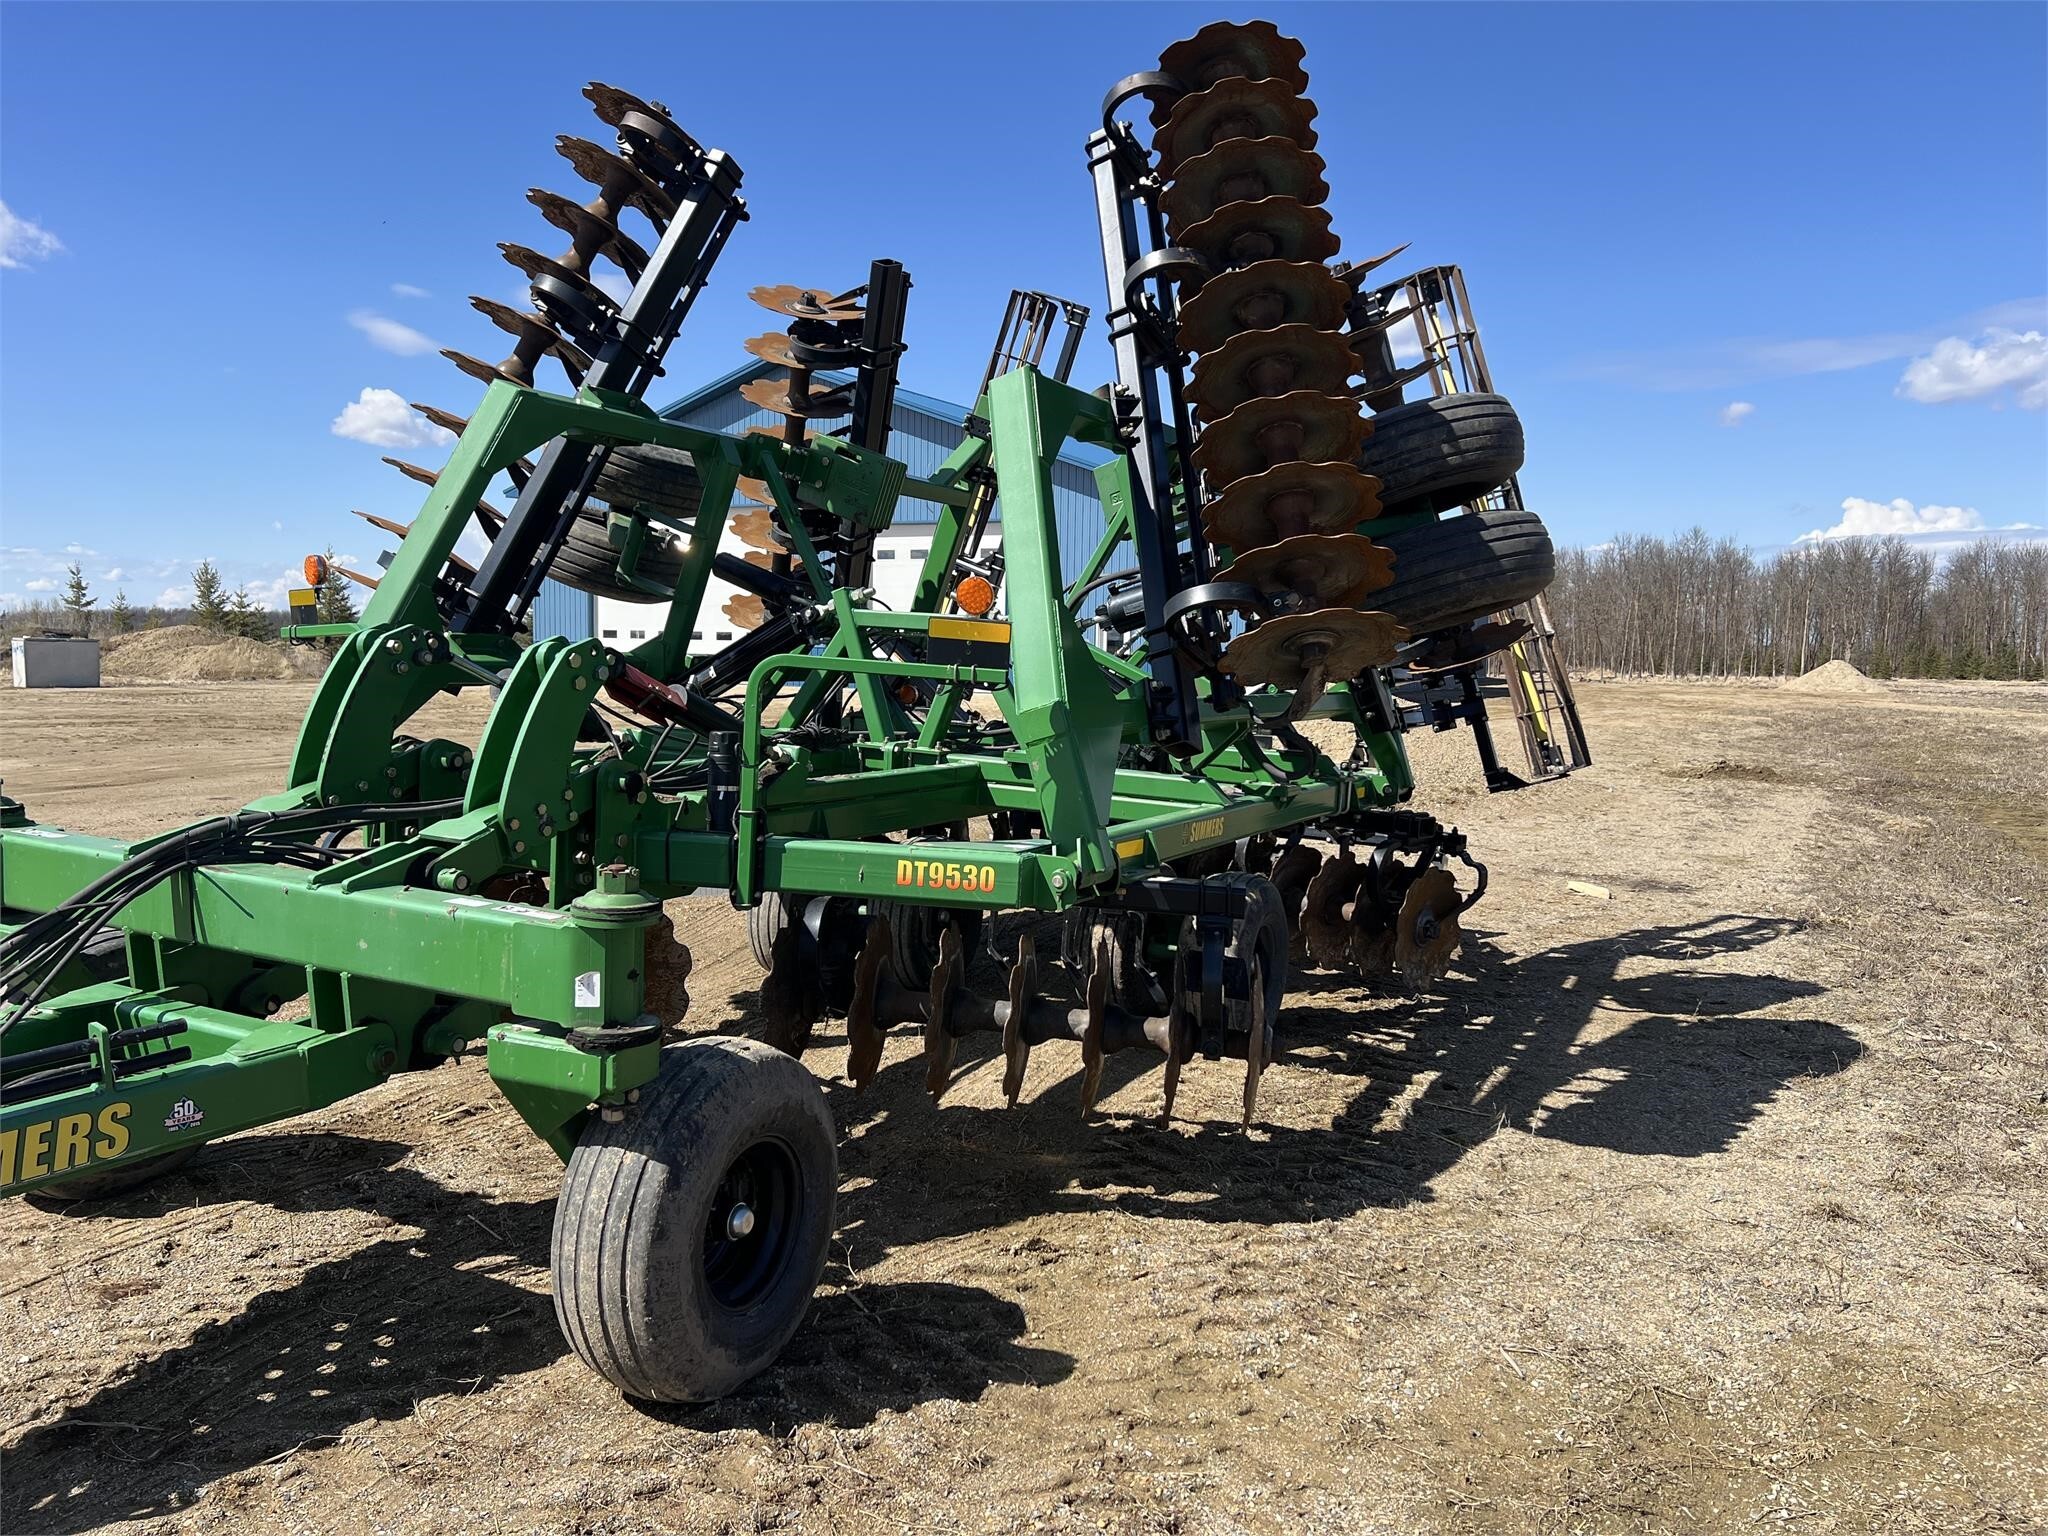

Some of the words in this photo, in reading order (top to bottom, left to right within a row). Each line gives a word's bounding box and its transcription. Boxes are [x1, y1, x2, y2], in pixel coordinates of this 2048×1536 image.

[1190, 816, 1224, 842] SUMMERS
[896, 859, 995, 893] DT9530
[174, 1100, 194, 1118] 50
